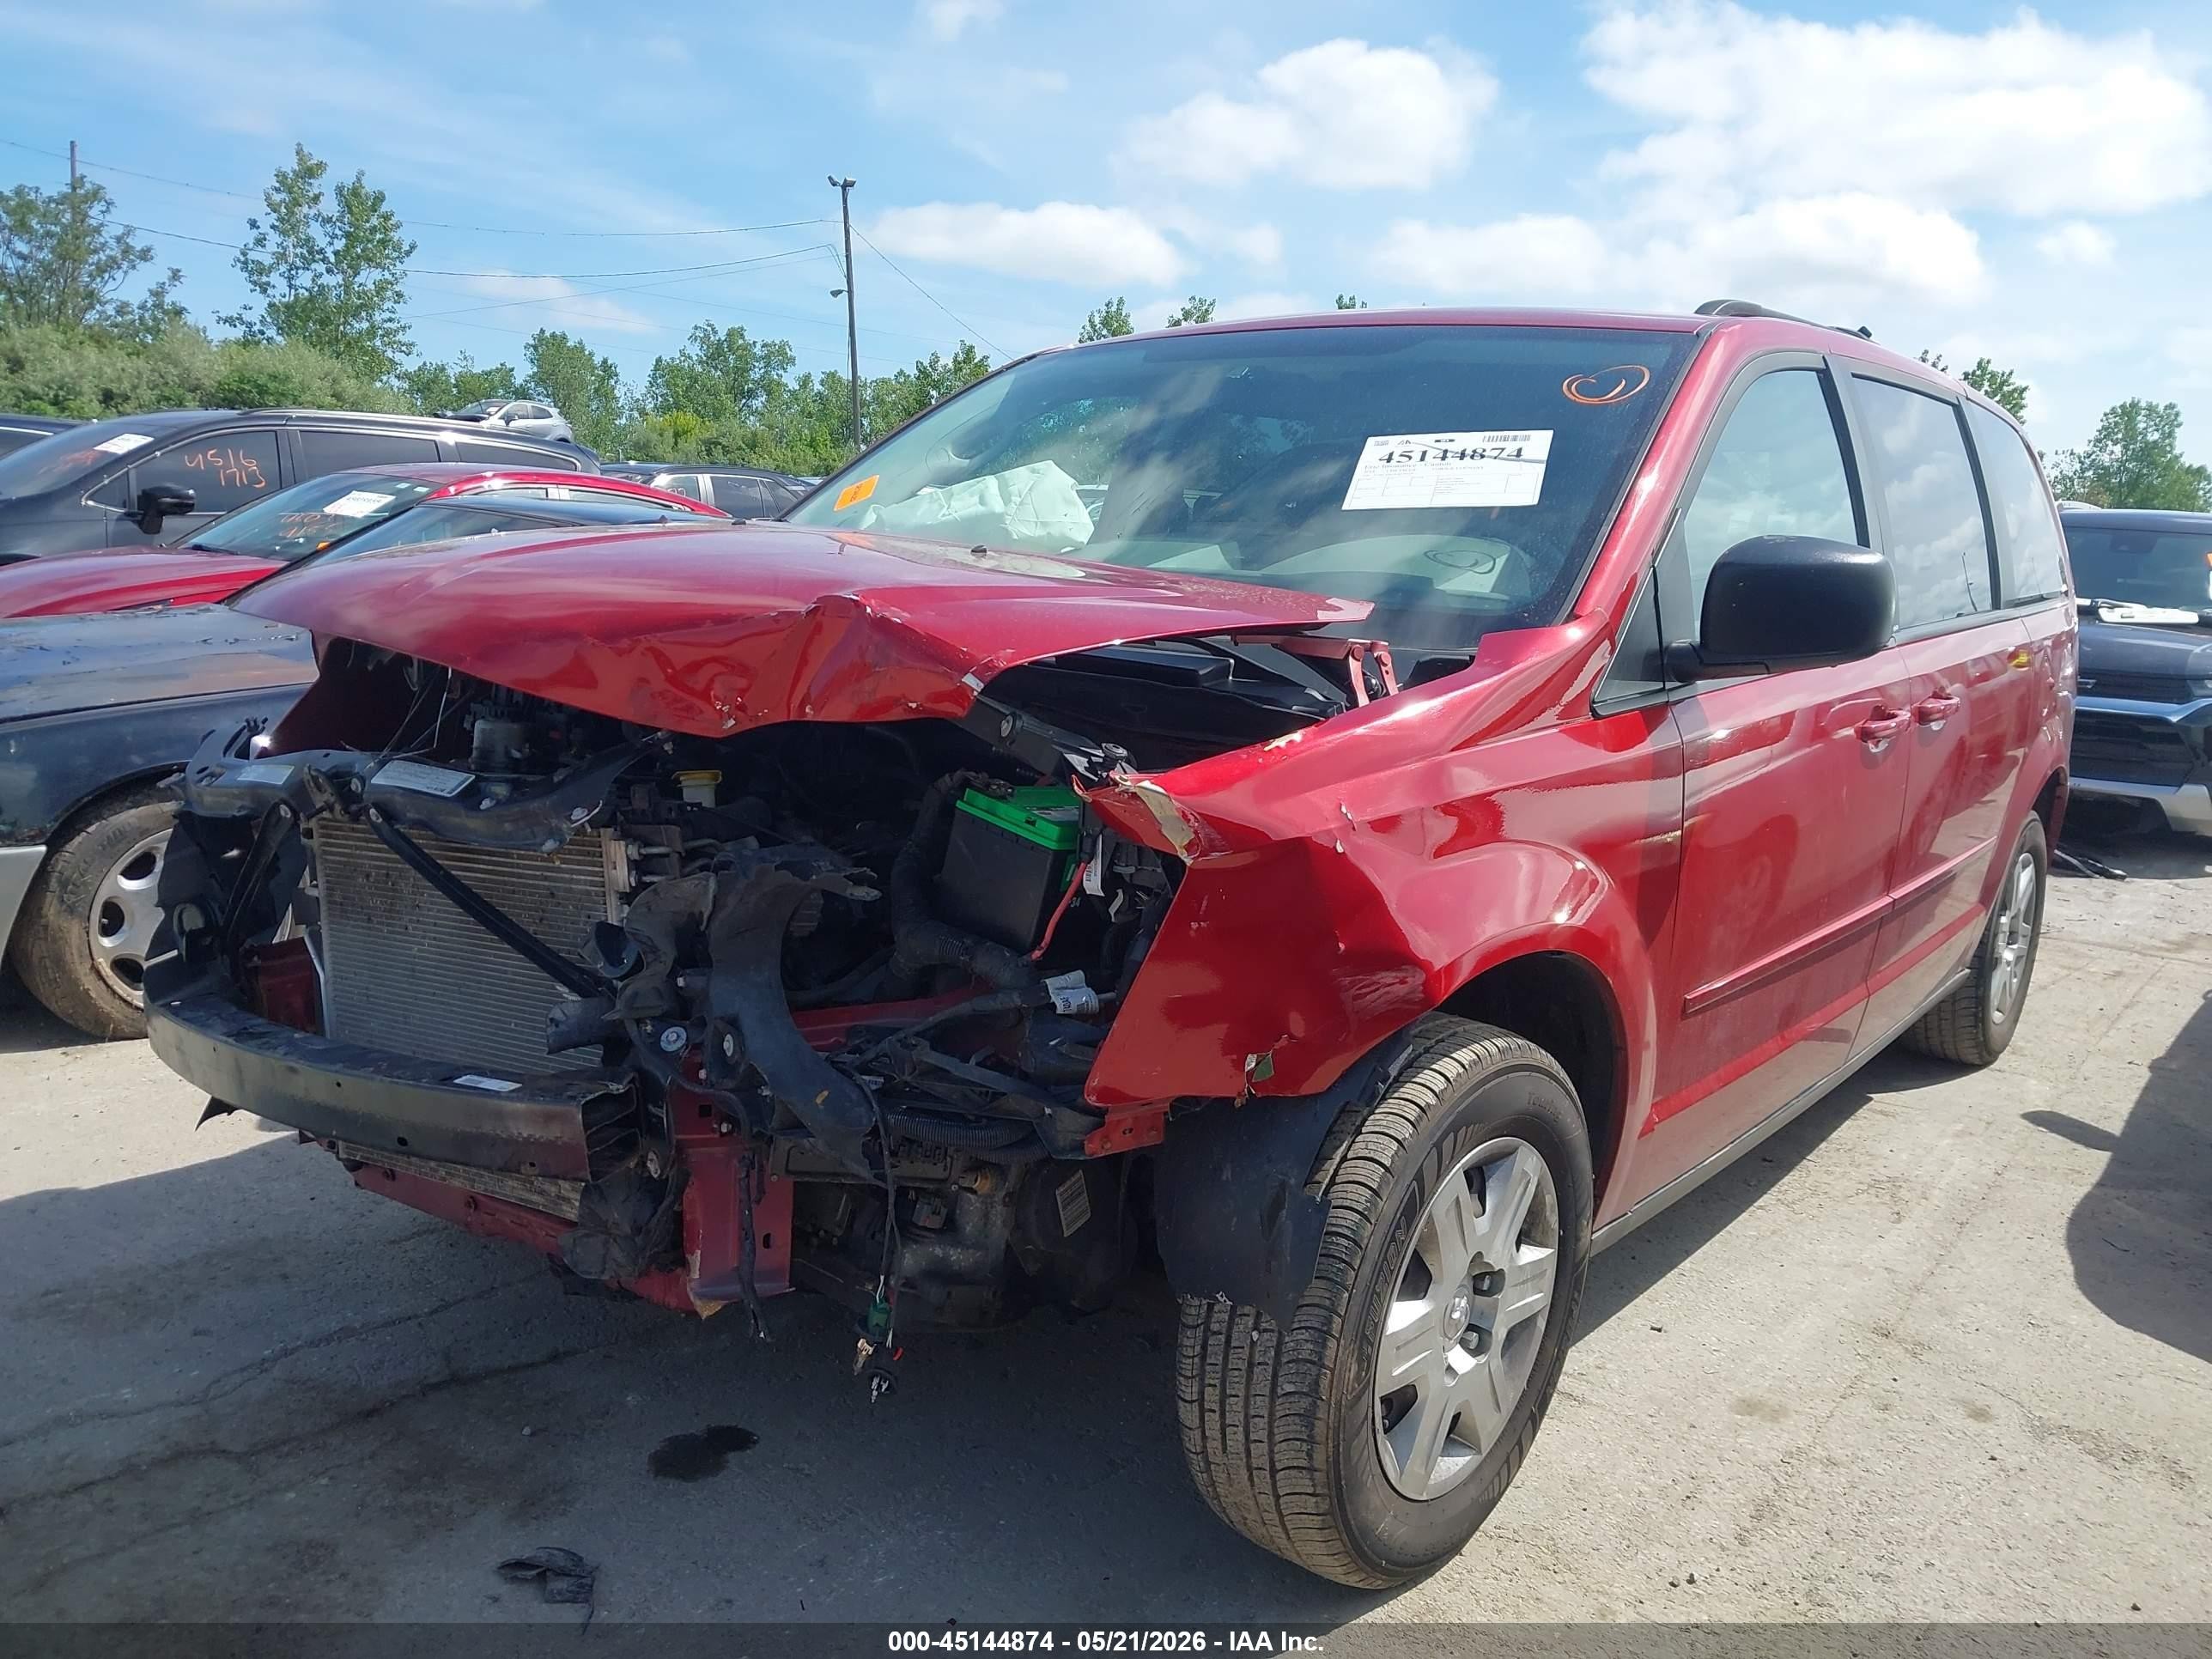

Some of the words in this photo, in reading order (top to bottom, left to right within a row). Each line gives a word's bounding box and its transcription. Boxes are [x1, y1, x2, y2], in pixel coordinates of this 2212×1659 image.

[185, 447, 257, 471] 4516
[1378, 447, 1524, 464] 45144874
[220, 465, 266, 489] 1713
